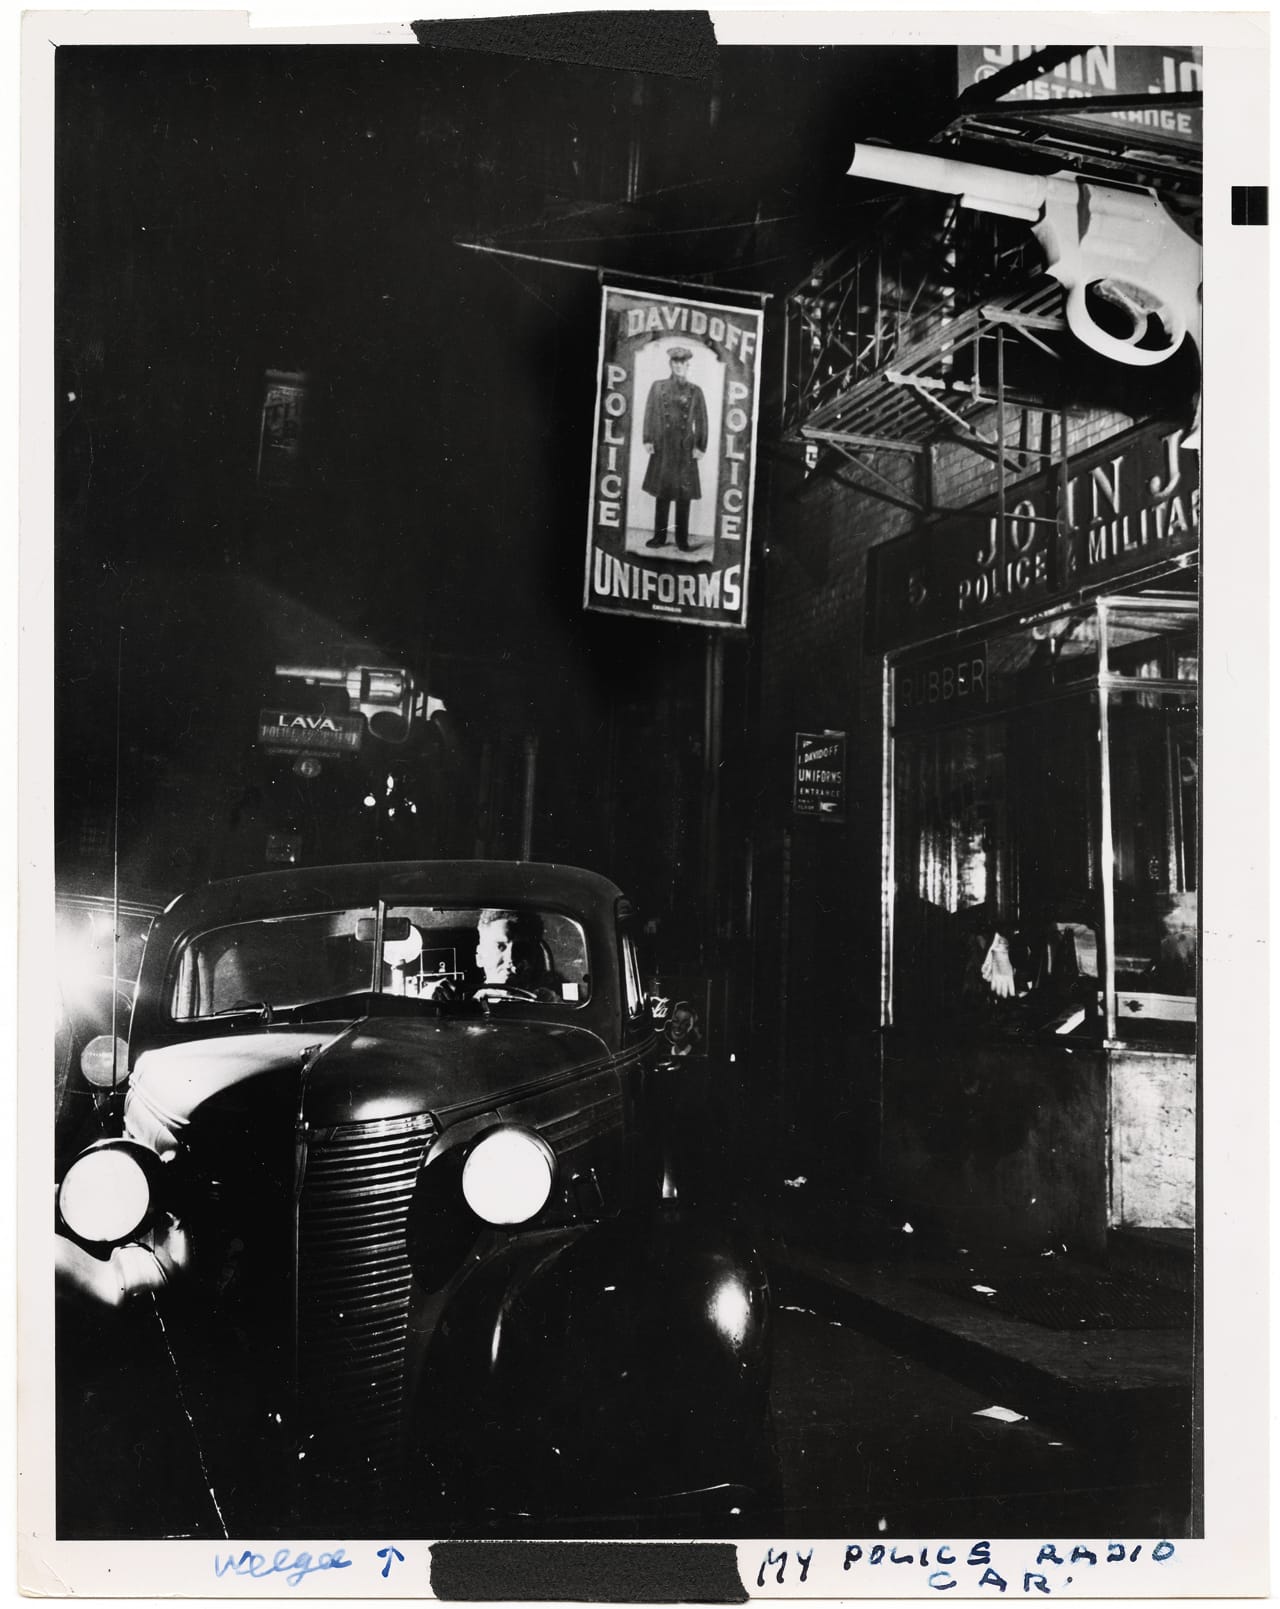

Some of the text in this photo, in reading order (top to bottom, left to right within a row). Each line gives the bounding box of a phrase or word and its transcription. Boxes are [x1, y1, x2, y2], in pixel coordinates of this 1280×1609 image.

[626, 305, 757, 365] DAVIDOFF
[598, 364, 627, 528] POLICE
[719, 380, 749, 541] POLICE
[593, 545, 742, 612] UNIFORMS
[958, 548, 1048, 611] POLICE
[902, 658, 985, 706] RUBBER
[798, 768, 842, 784] UNIFORMS
[757, 1547, 814, 1587] MY
[1036, 1540, 1176, 1566] RADIO
